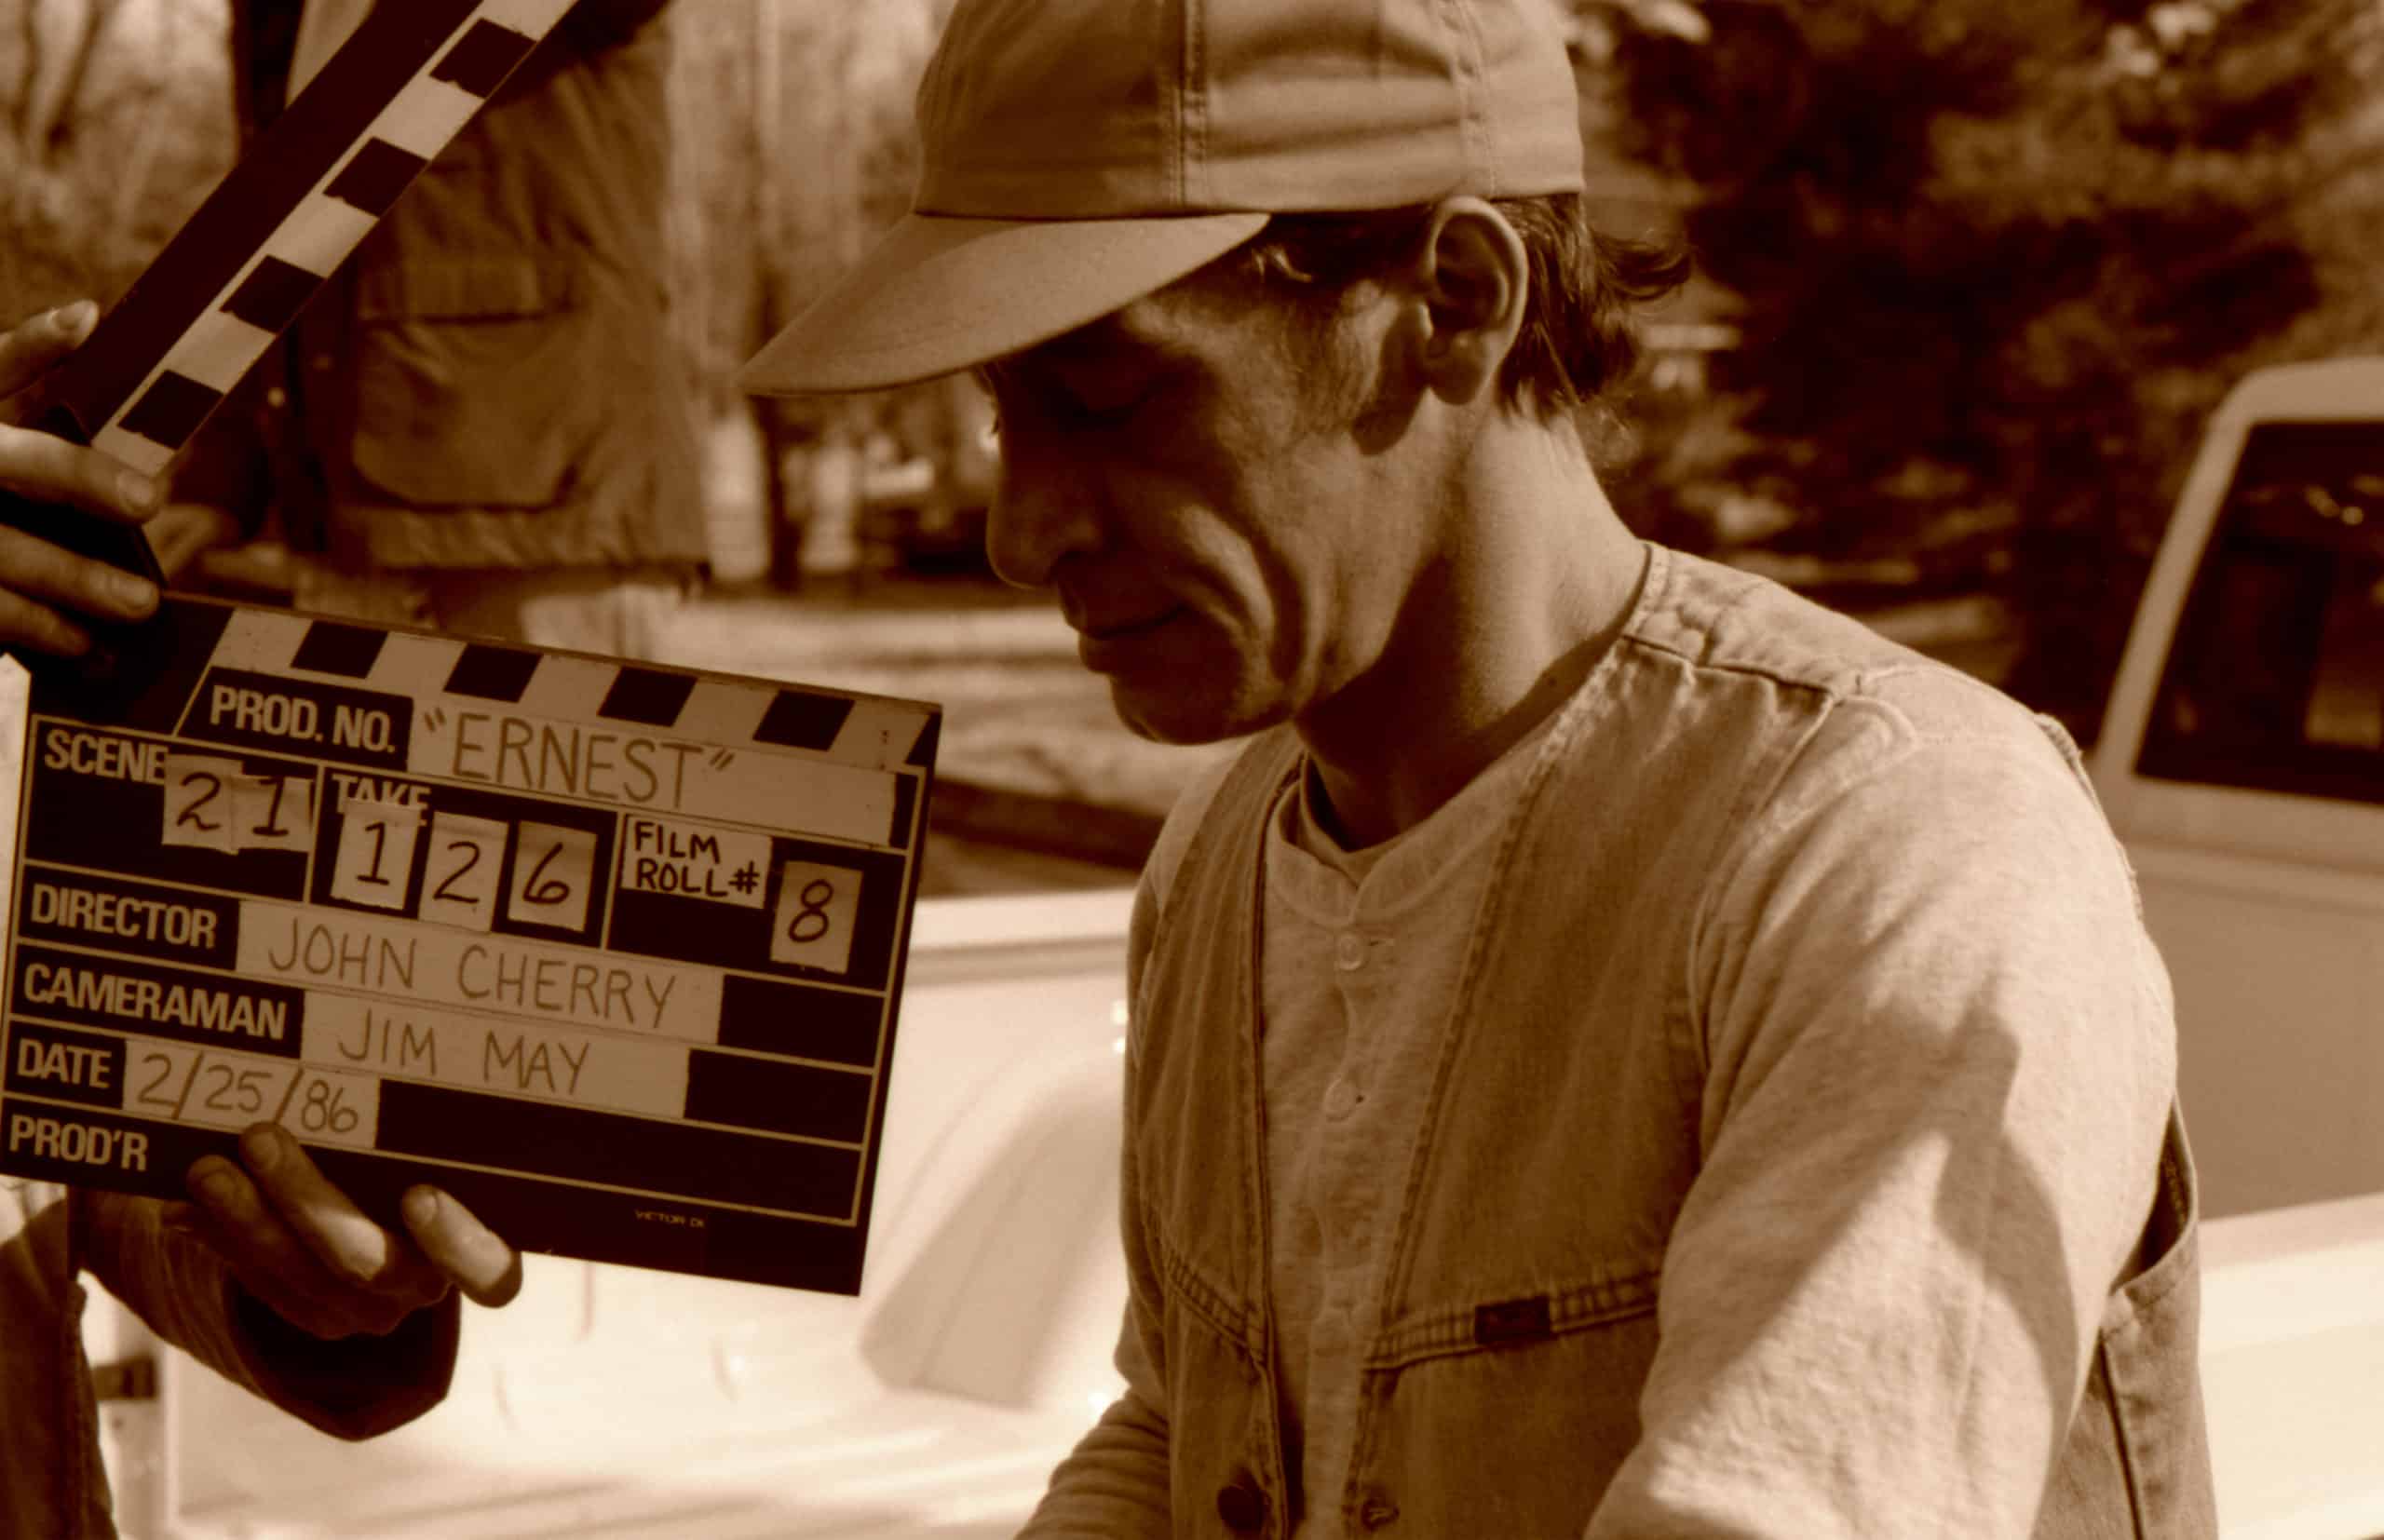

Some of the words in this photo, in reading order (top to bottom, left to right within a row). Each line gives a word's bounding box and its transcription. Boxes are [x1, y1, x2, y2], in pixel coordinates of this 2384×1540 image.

[210, 684, 323, 741] PROD.
[332, 706, 396, 753] NO.
[45, 728, 169, 785] SCENE
[424, 708, 735, 808] "ERNEST"
[633, 820, 720, 864] FILM
[31, 883, 217, 950] DIRECTOR
[788, 878, 834, 943] 8
[23, 963, 287, 1039] CAMERAMAN
[268, 917, 416, 989] JOHN
[457, 944, 676, 1028] CHERRY
[18, 1037, 112, 1088] DATE
[338, 1007, 436, 1075] JIM
[483, 1030, 589, 1095] MAY
[137, 1050, 359, 1133] 2/25/86
[9, 1114, 148, 1171] PROD'R
